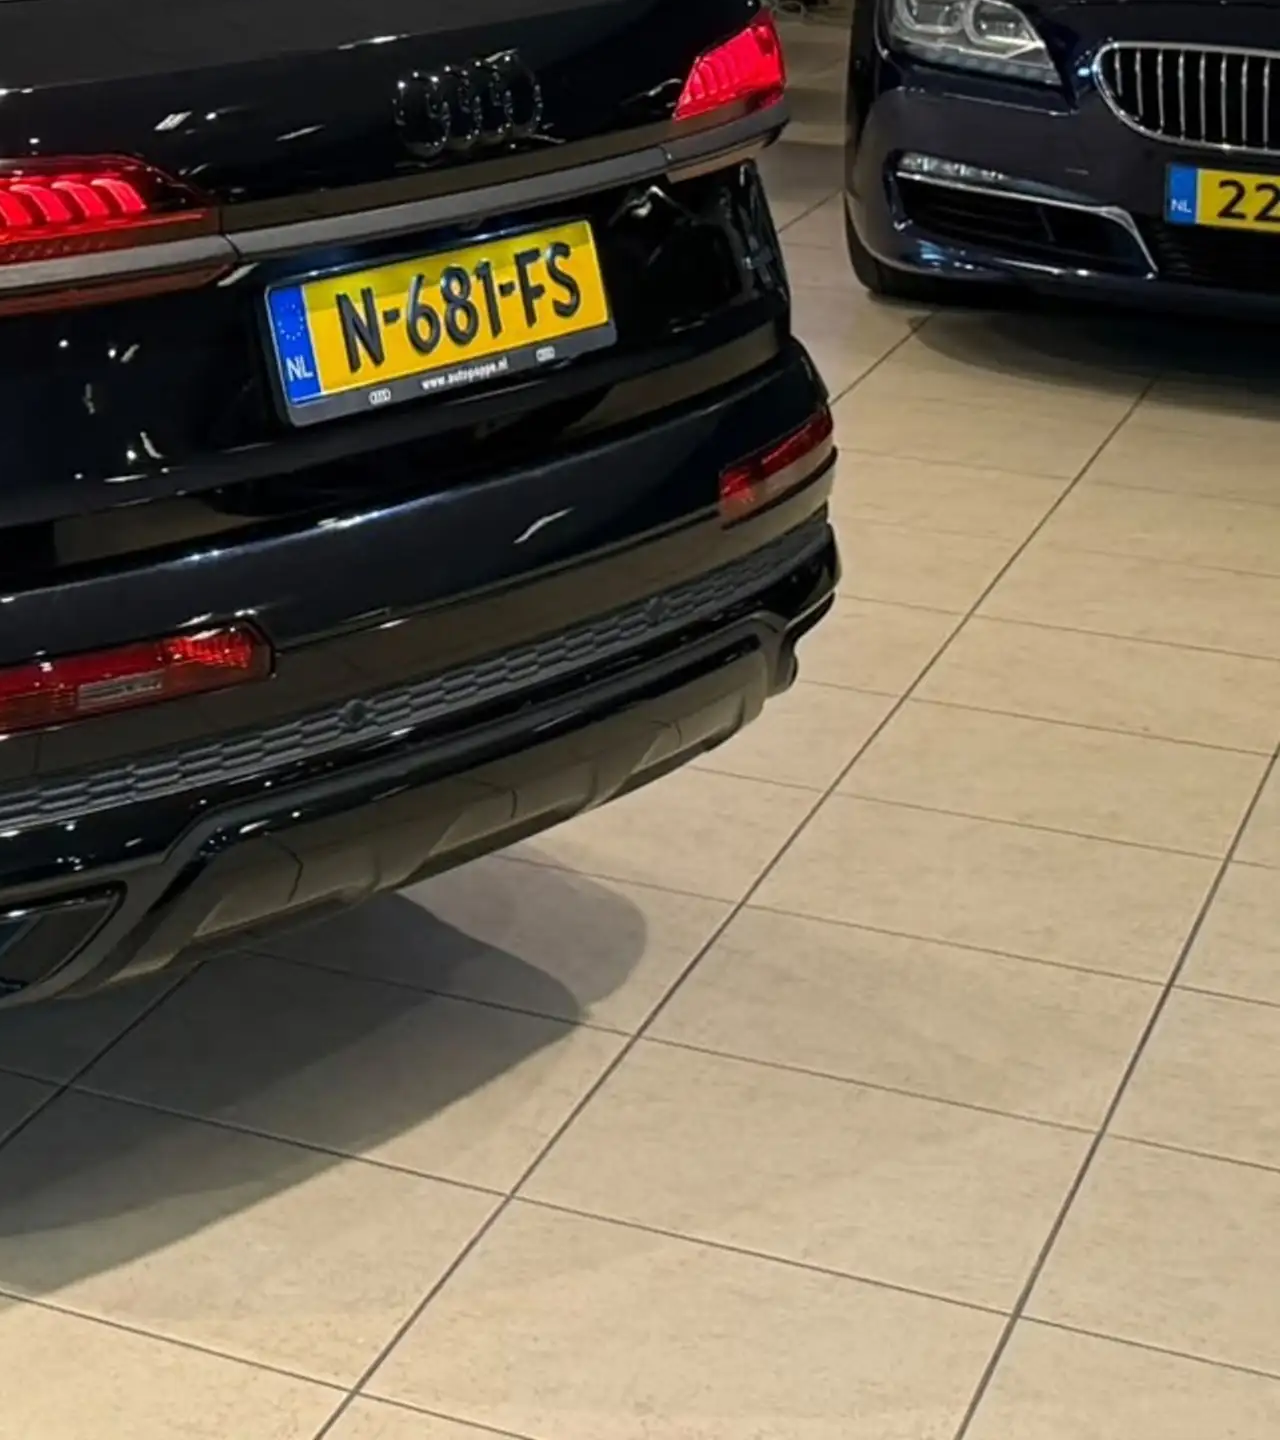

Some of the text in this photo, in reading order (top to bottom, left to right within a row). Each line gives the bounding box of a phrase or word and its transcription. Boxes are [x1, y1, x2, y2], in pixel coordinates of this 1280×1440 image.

[1170, 198, 1192, 214] NL
[335, 241, 581, 374] N-681-FS
[286, 355, 314, 381] NL
